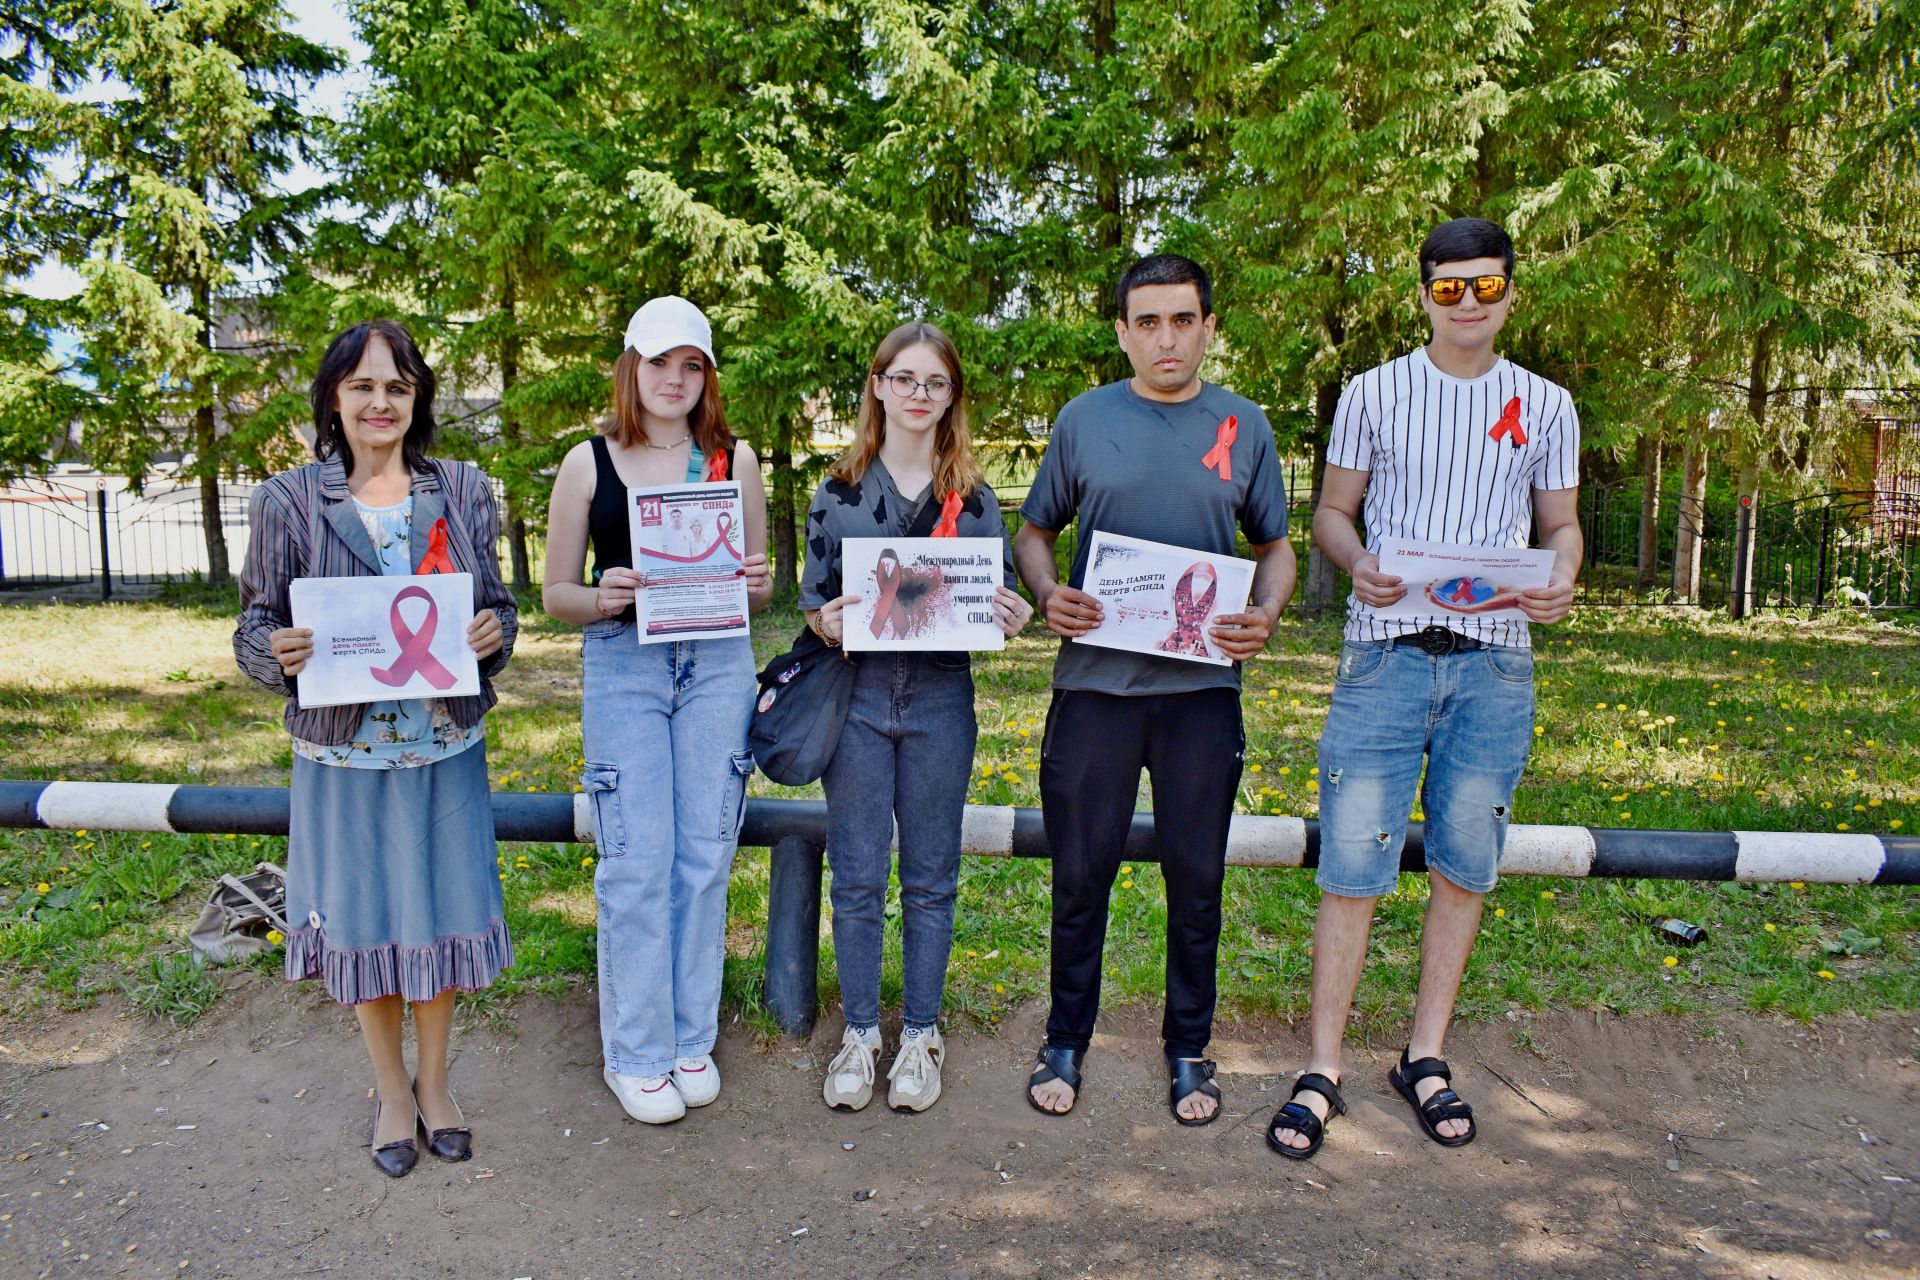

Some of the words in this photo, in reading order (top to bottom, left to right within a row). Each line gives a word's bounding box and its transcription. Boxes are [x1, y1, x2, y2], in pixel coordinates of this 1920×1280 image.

[643, 502, 659, 517] 21
[702, 500, 734, 510] СПИДа
[918, 555, 974, 568] Международный
[976, 555, 992, 567] День
[943, 575, 969, 584] памяти
[970, 574, 992, 584] людей,
[1127, 574, 1165, 584] ПАМЯТИ
[1133, 584, 1164, 592] СПИДА
[954, 596, 983, 606] умерших
[968, 612, 992, 624] СПИДа
